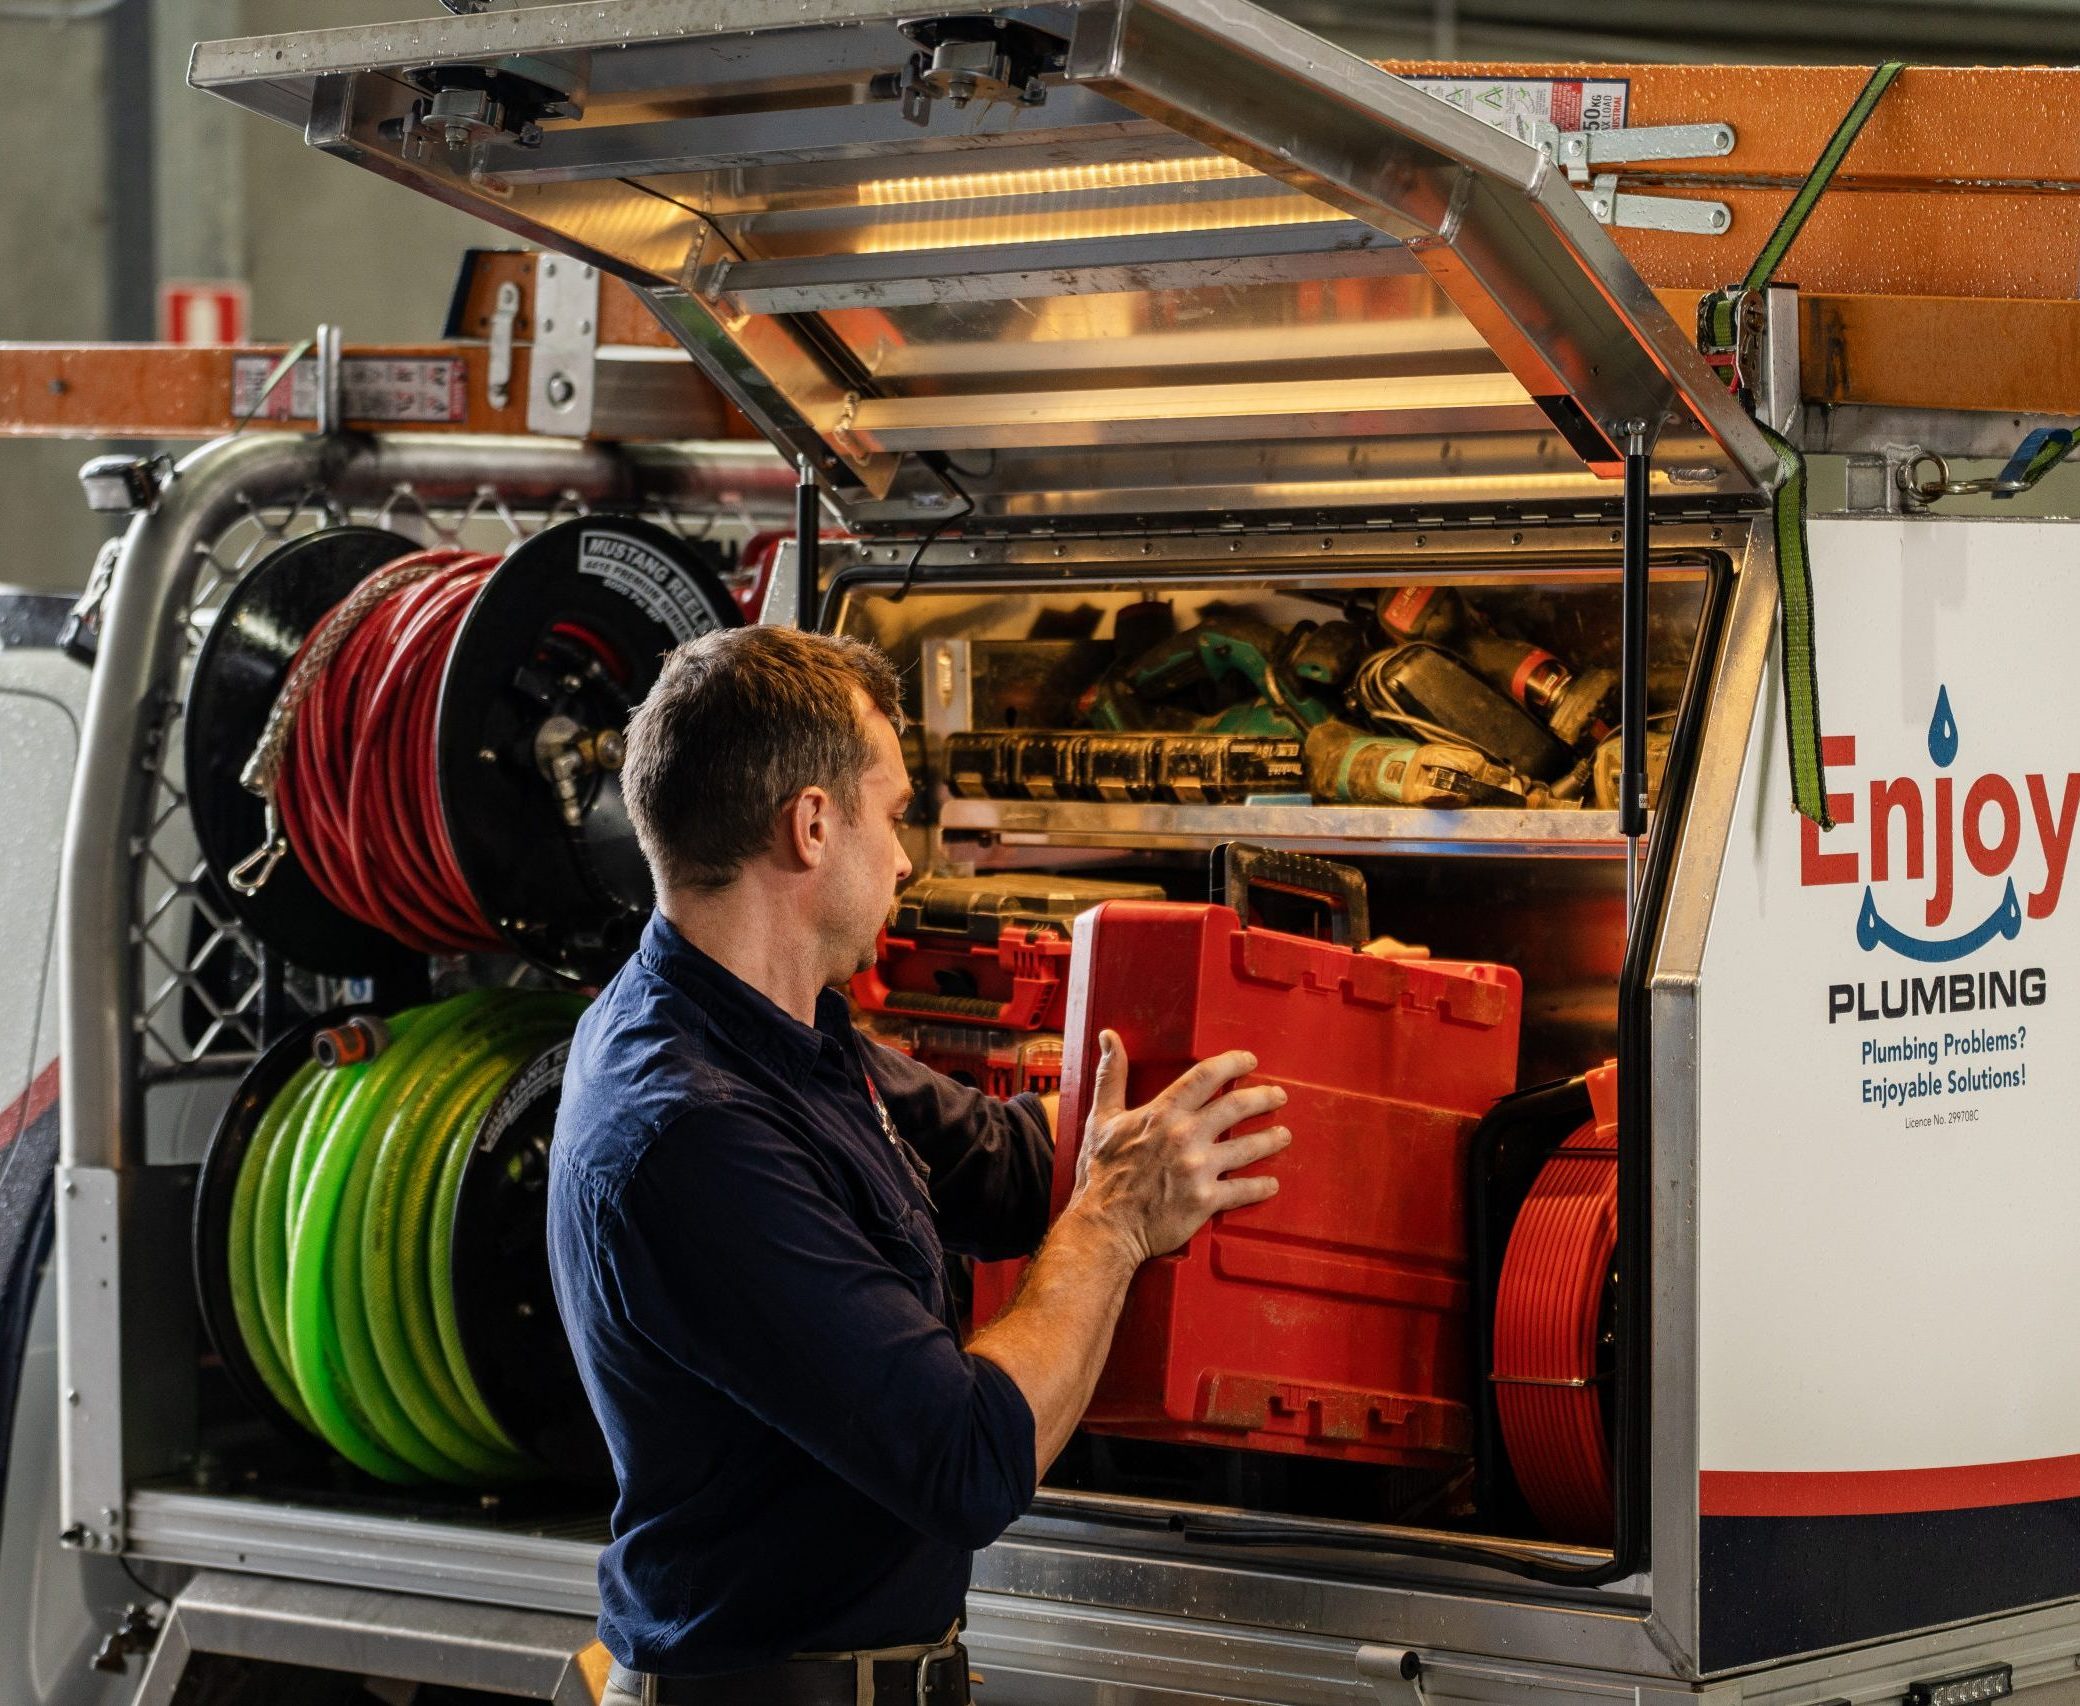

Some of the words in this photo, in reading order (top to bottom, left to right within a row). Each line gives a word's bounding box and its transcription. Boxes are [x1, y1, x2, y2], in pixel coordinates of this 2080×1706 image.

[1583, 94, 1602, 131] 50KG
[1602, 95, 1613, 118] LOAD
[1612, 95, 1622, 130] USTRIAL
[1600, 121, 1611, 131] AX
[588, 539, 669, 582] MUSTANG
[614, 566, 662, 599] PREMIUM
[1801, 735, 2080, 927] Enjoy
[1829, 967, 2047, 1024] PLUMBING
[1862, 1036, 1938, 1065] Plumbing
[1944, 1025, 2027, 1056] Problems?
[1862, 1072, 1942, 1108] Enjoyable
[1948, 1063, 2026, 1095] Solutions!
[1905, 1117, 1932, 1129] Licence
[1933, 1113, 1947, 1126] No.
[1948, 1109, 1979, 1124] 299708C
